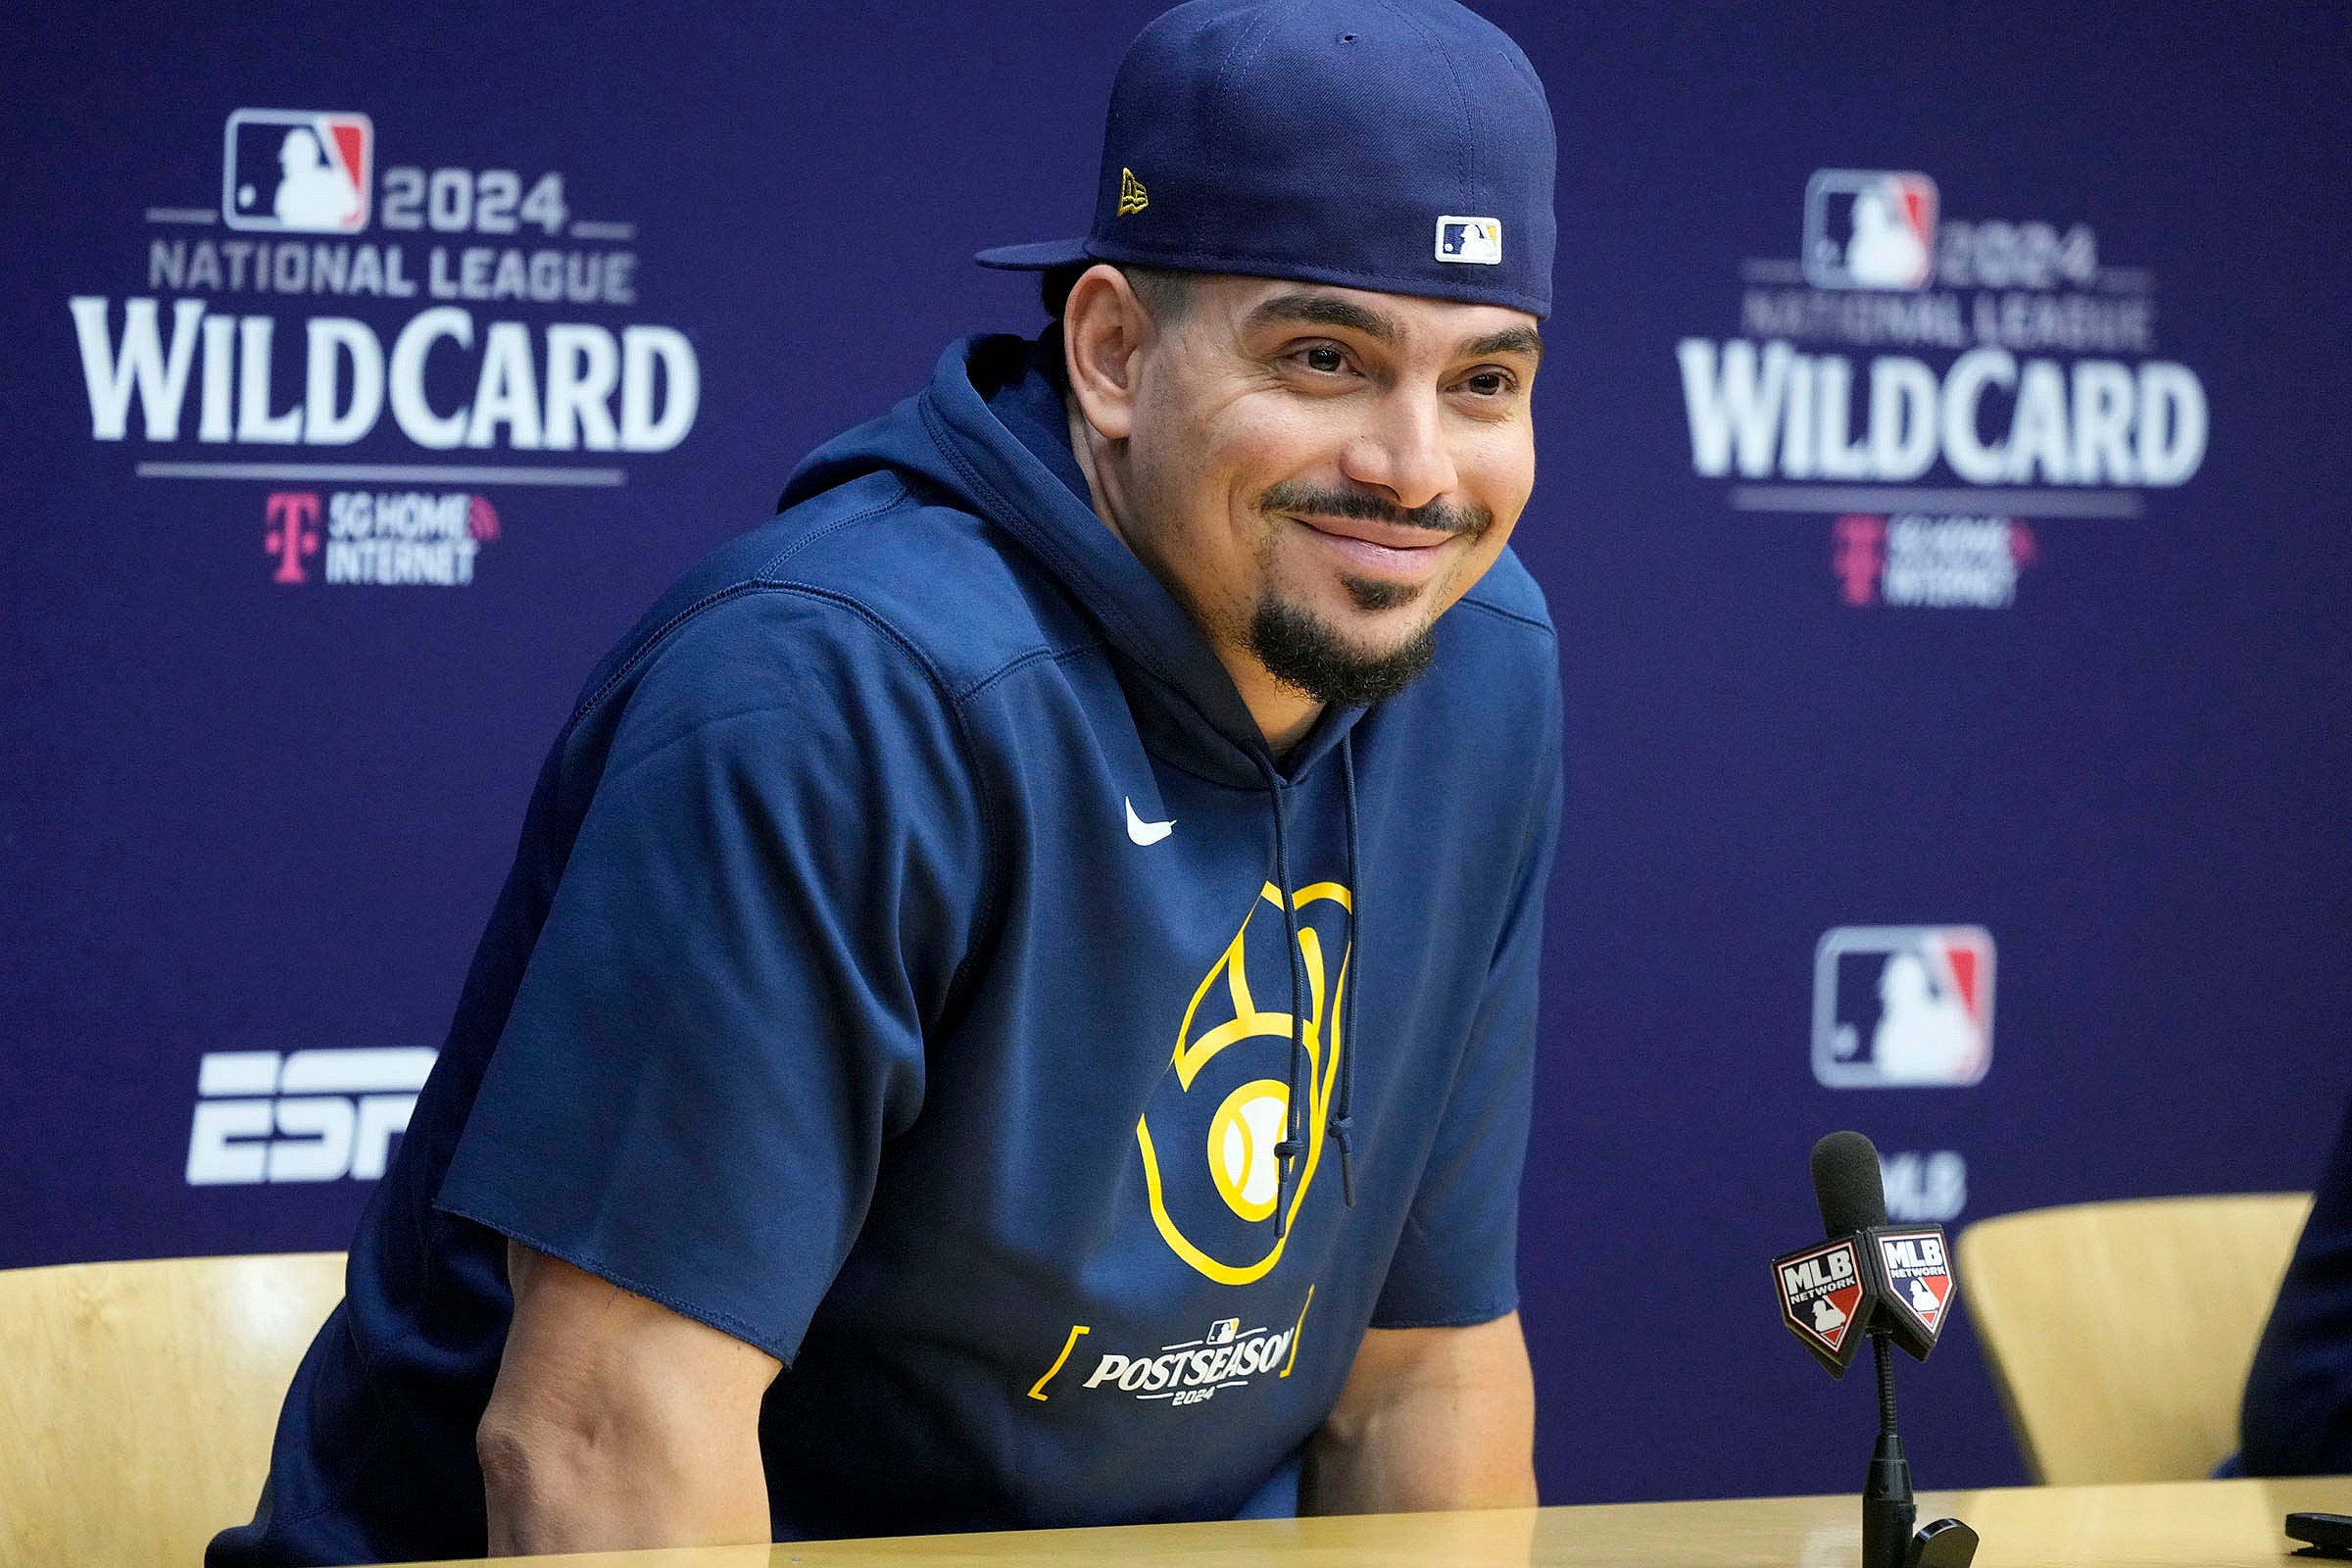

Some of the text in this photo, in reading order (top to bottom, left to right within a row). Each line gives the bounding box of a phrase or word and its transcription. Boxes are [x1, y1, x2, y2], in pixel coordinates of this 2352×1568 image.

[382, 167, 568, 234] 2024
[148, 241, 638, 305] NATIONAL LEAGUE
[185, 1046, 440, 1186] ESP
[1784, 1250, 1853, 1296] MLB
[1883, 1238, 1944, 1270] MLB
[1890, 1264, 1947, 1280] NETWORK
[1789, 1276, 1857, 1305] NETWORK
[1171, 1386, 1216, 1406] 2024
